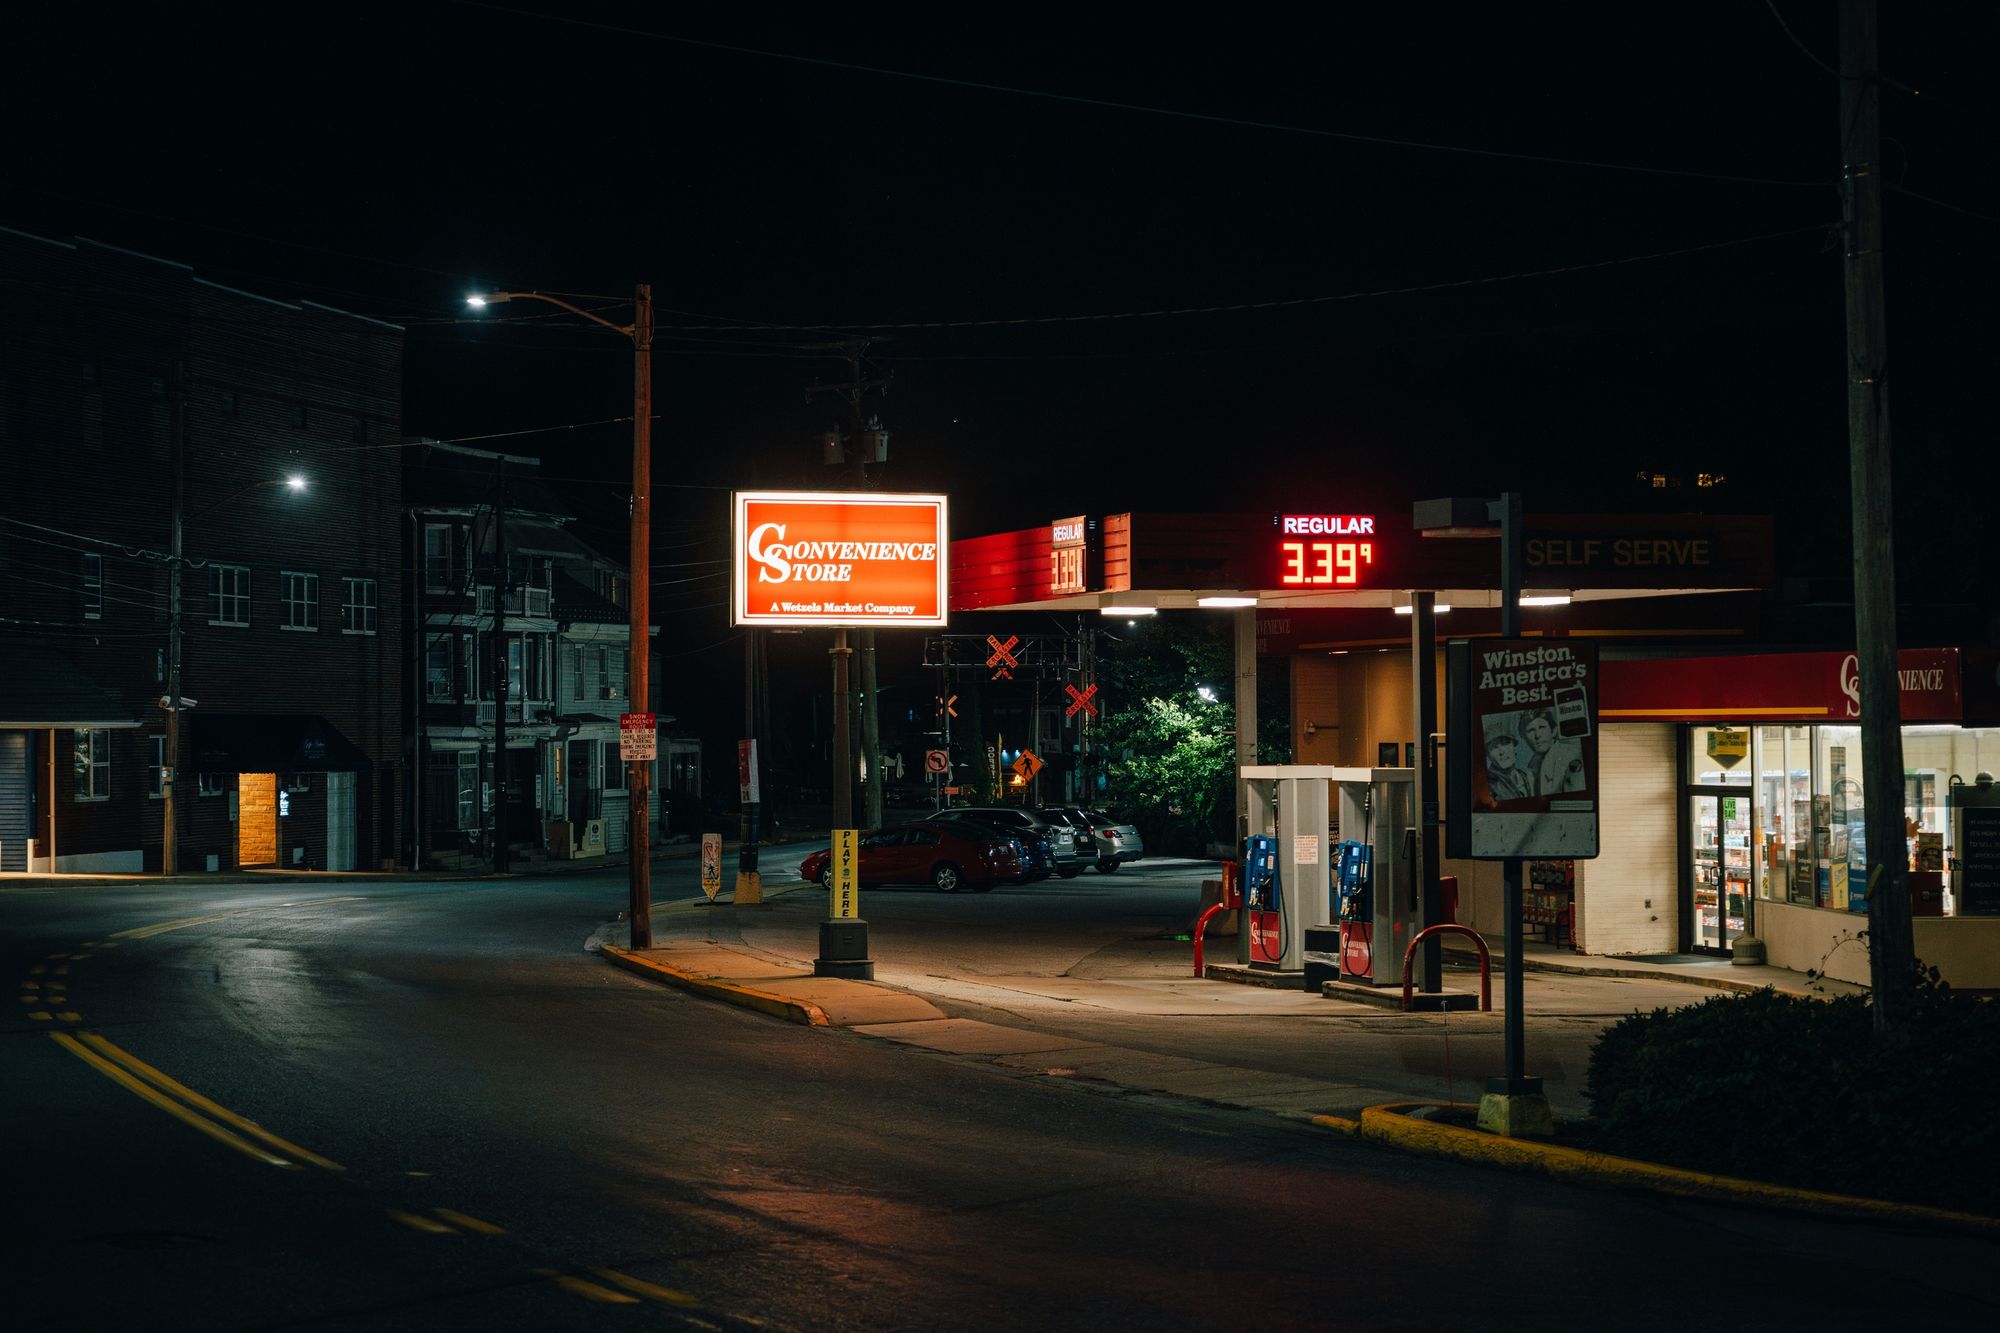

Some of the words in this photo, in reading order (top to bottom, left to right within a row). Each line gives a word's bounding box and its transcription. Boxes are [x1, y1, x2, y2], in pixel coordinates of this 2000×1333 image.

[1053, 523, 1083, 542] REGULAR
[1284, 517, 1374, 534] REGULAR
[748, 522, 936, 563] CONVENIENCE
[1525, 538, 1602, 567] SELF
[1613, 538, 1712, 567] SERVE
[758, 543, 852, 584] STORE
[770, 601, 780, 612] A
[782, 601, 822, 613] Wetzels
[823, 601, 863, 613] Market
[864, 601, 916, 615] Company
[989, 637, 1000, 650] RAIL
[1004, 653, 1017, 667] ROAD
[1483, 645, 1576, 671] Winston.
[1479, 661, 1587, 690] America's
[1067, 686, 1080, 699] RAIL
[1067, 685, 1096, 716] CROSSING
[1502, 684, 1553, 706] Best.
[1724, 800, 1736, 809] LIVE
[843, 831, 851, 866] PLAY
[842, 882, 851, 917] HERE
